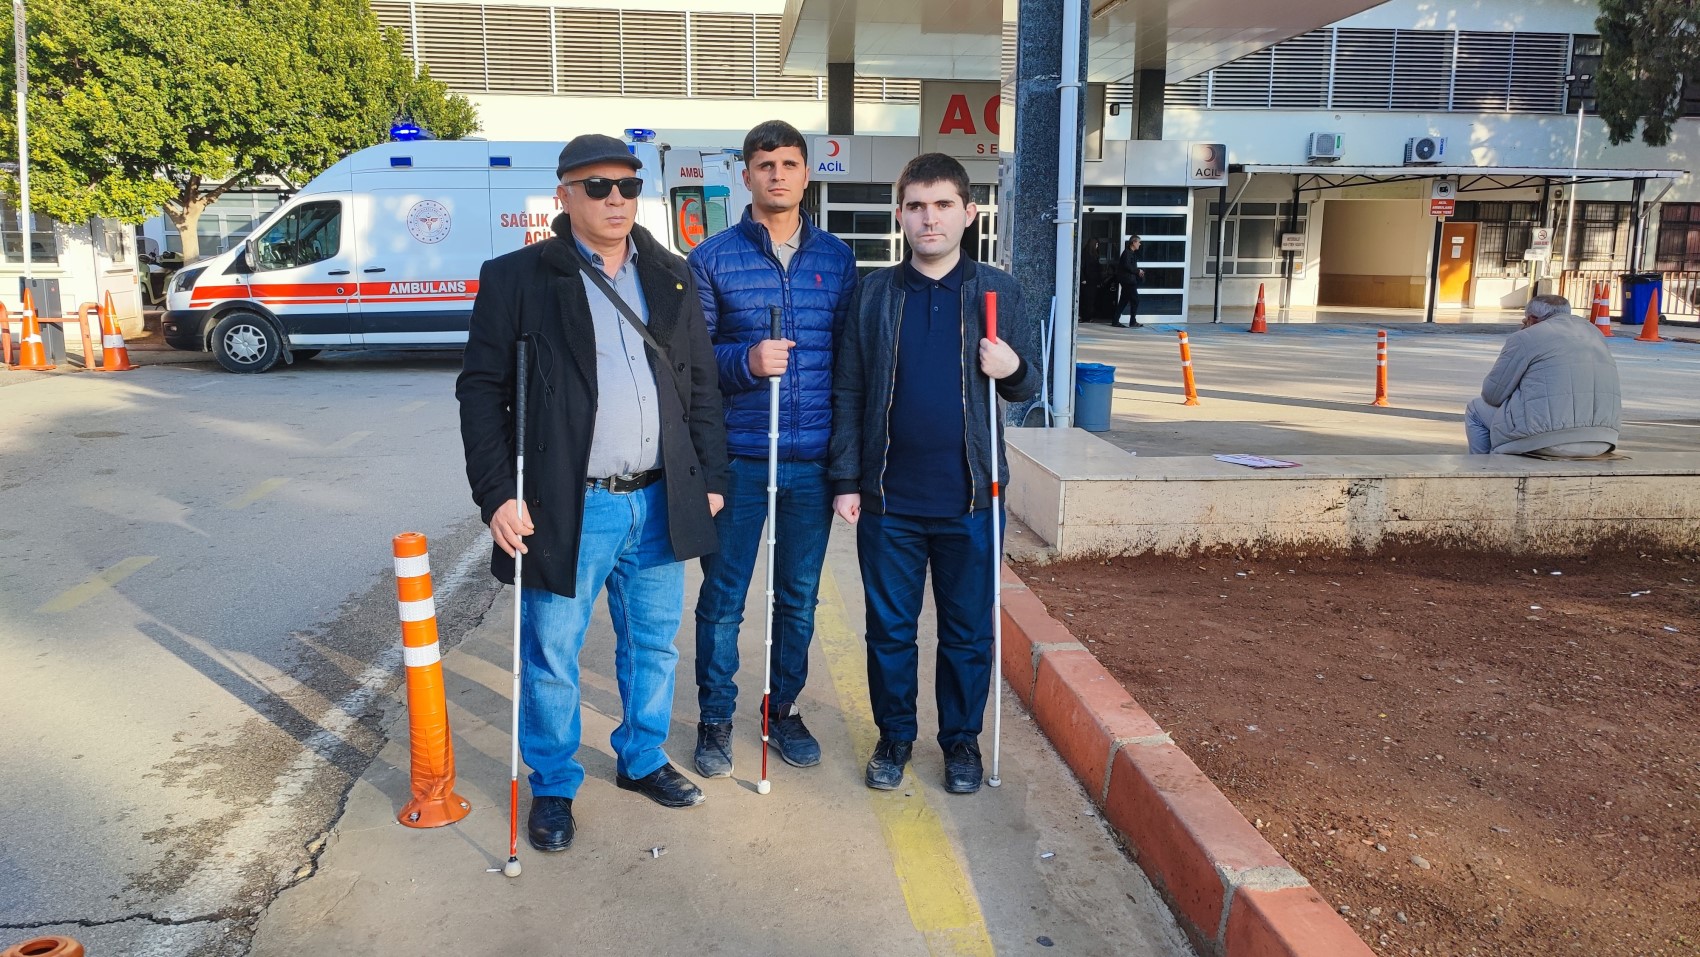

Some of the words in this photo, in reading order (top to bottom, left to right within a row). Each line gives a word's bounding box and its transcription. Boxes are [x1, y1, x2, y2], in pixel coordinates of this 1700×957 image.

[818, 160, 846, 172] ACİL
[500, 211, 549, 228] SAĞLIK
[389, 281, 467, 295] AMBULANS
